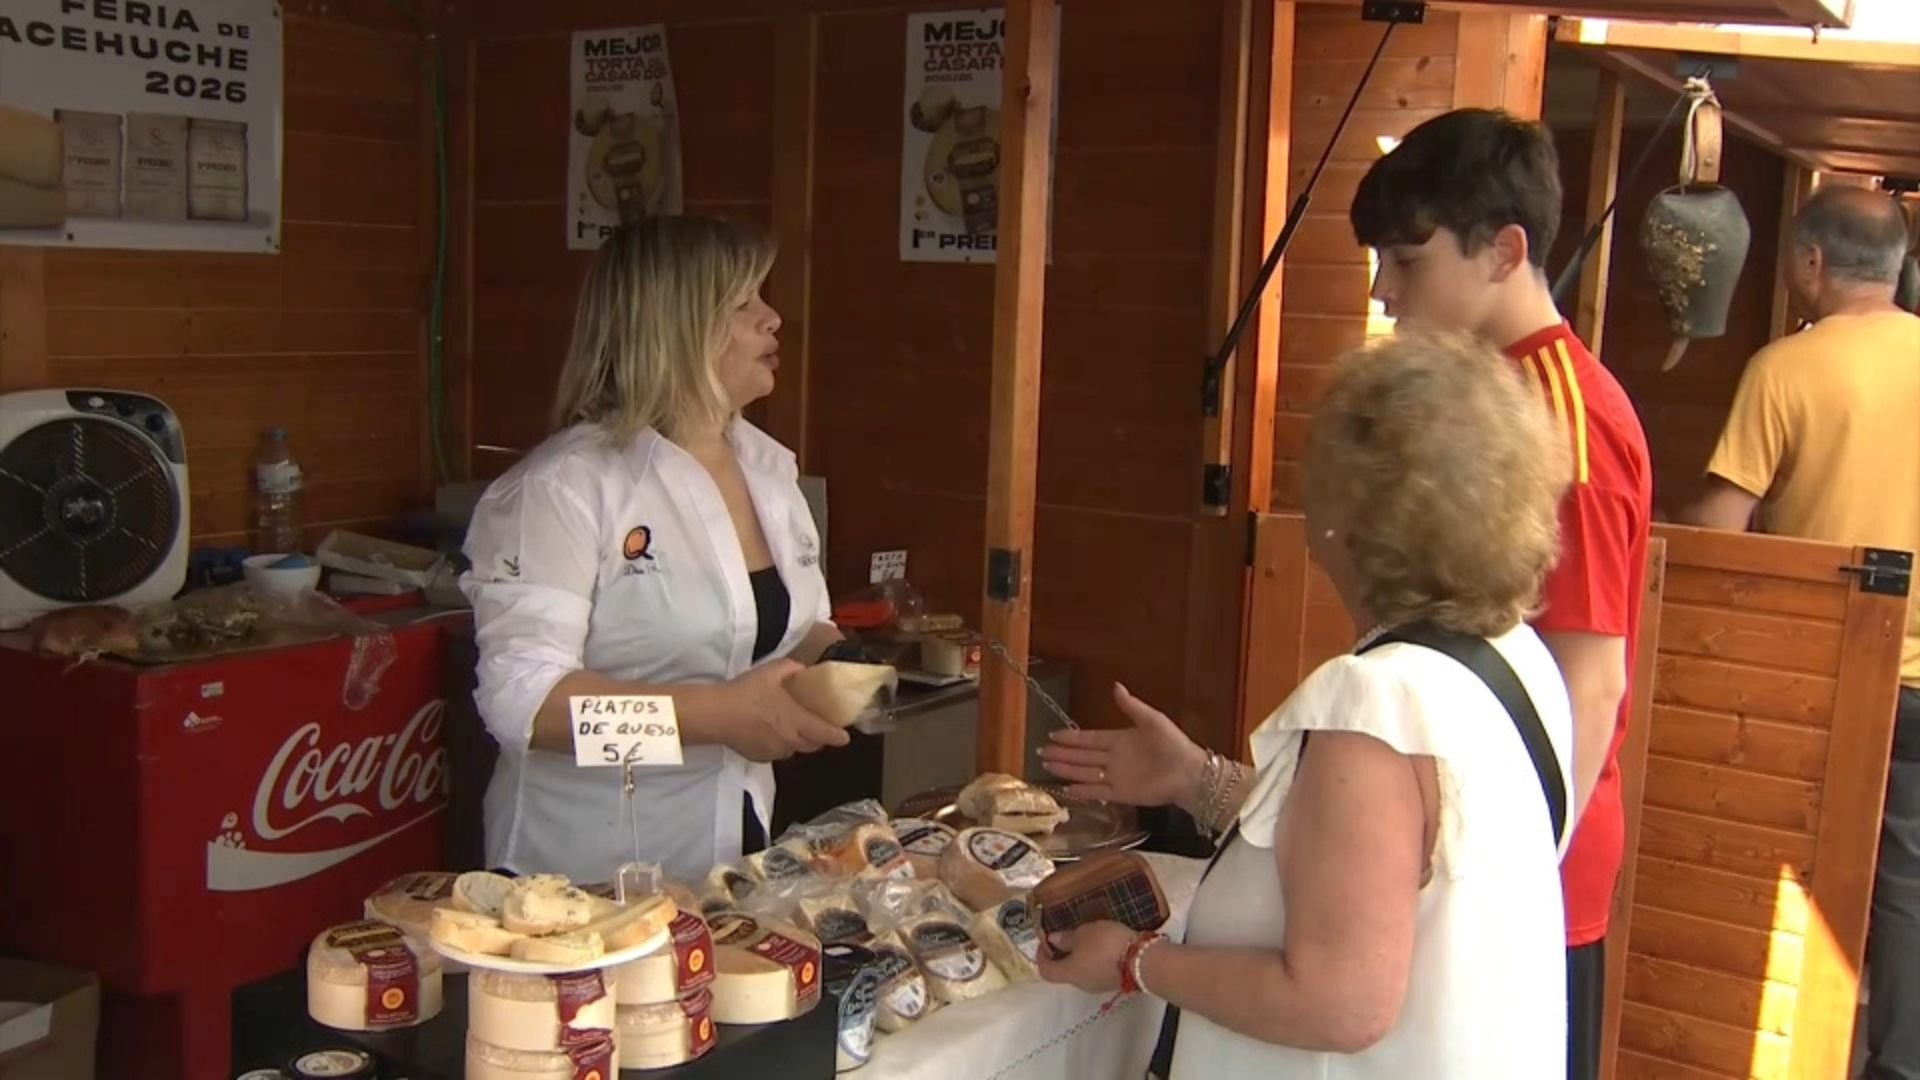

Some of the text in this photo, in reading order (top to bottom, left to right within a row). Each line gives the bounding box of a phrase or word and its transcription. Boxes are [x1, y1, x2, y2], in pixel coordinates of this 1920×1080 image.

[61, 0, 249, 38] FERIA DE
[0, 16, 248, 71] ACEHUCHE
[925, 41, 1001, 58] TORTA
[585, 56, 645, 71] TORTA
[924, 57, 995, 72] CASAR
[585, 69, 640, 82] CASAR
[145, 71, 247, 103] 2026
[581, 698, 659, 715] PLATOS
[579, 721, 676, 737] DE QUESO
[253, 699, 449, 840] Coca-Co
